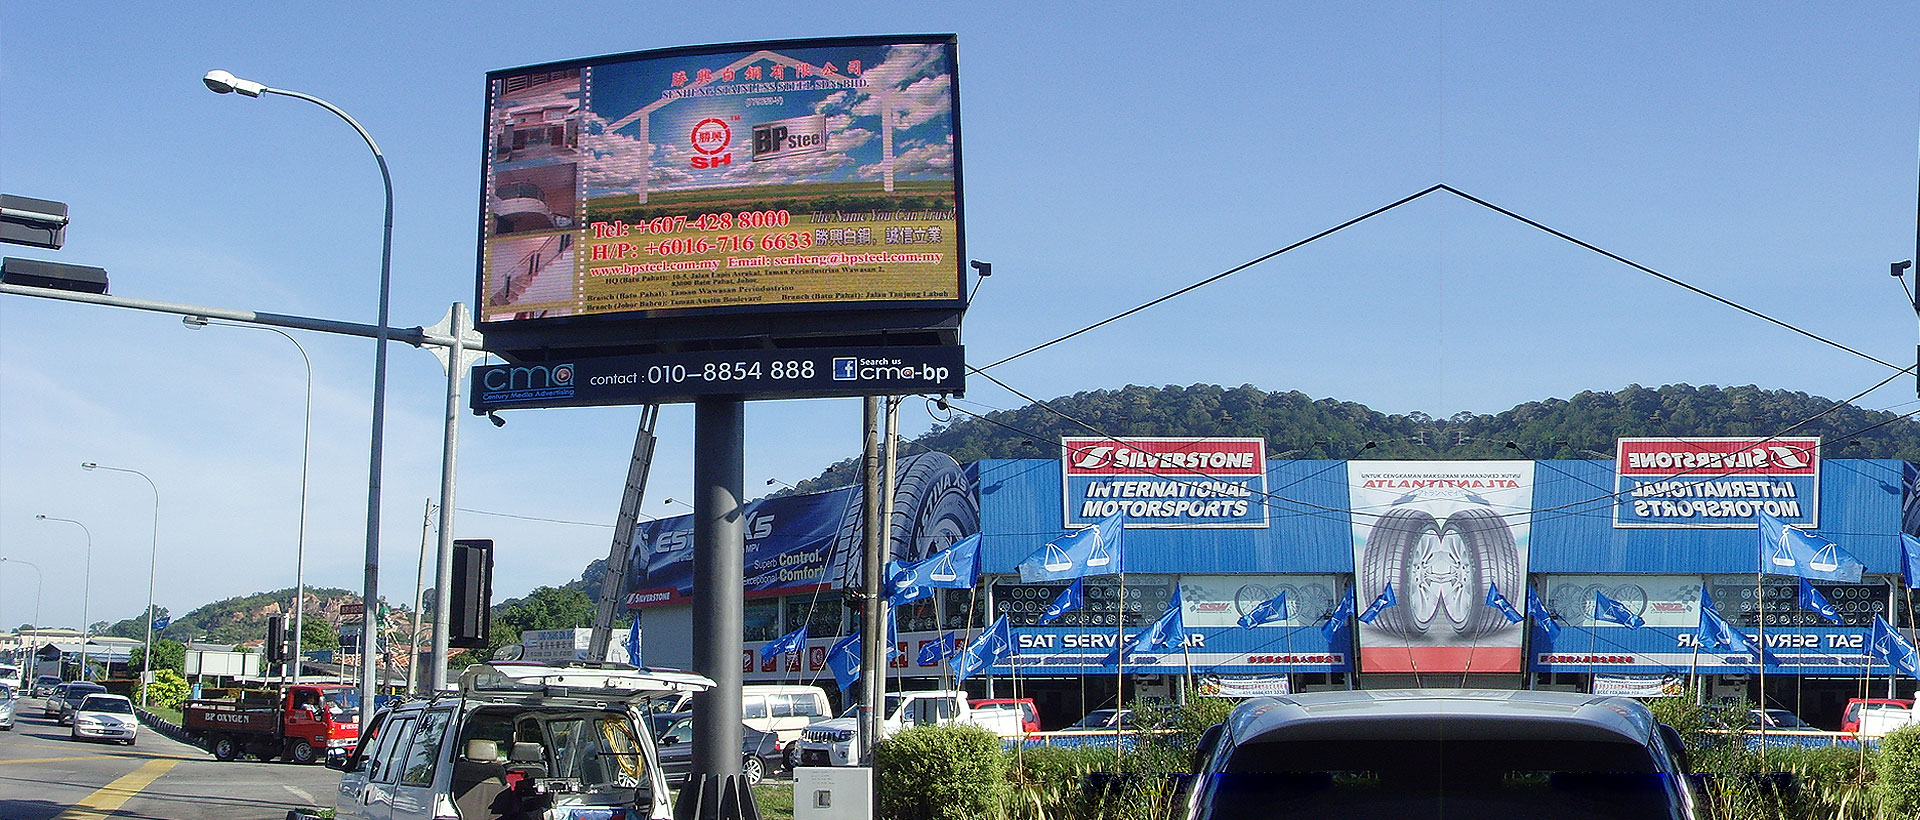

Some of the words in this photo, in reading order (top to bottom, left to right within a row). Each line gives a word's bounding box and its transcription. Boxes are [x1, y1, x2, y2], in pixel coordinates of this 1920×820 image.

[715, 82, 776, 95] STAINLESS
[777, 81, 814, 91] STEEL
[753, 126, 788, 155] BP
[690, 153, 731, 169] SH
[591, 220, 628, 238] Tel:
[635, 212, 733, 235] +607-428
[738, 210, 790, 229] 8000
[810, 210, 831, 223] The
[832, 210, 866, 222] Name
[870, 208, 892, 221] You
[895, 208, 918, 221] Can
[590, 241, 638, 261] H/P:
[644, 233, 756, 256] +6016-716
[761, 231, 813, 250] 6633
[590, 259, 720, 276] www.bpsteel.com.my
[727, 255, 771, 268] Email:
[773, 251, 943, 267] senheng@bpsteel.com.my
[860, 357, 889, 366] Search
[590, 372, 638, 386] contact
[770, 360, 815, 380] 888
[860, 363, 949, 384] cma-bp
[482, 392, 510, 400] Century
[535, 389, 575, 397] Advertising
[1112, 448, 1254, 469] SILVERSTONE
[1086, 481, 1252, 499] INTERNATIONAL
[1082, 500, 1248, 518] MOTORSPORTS
[754, 558, 778, 570] Superb
[779, 549, 822, 566] Control.
[205, 713, 216, 721] BP
[217, 713, 250, 724] OXYGEN
